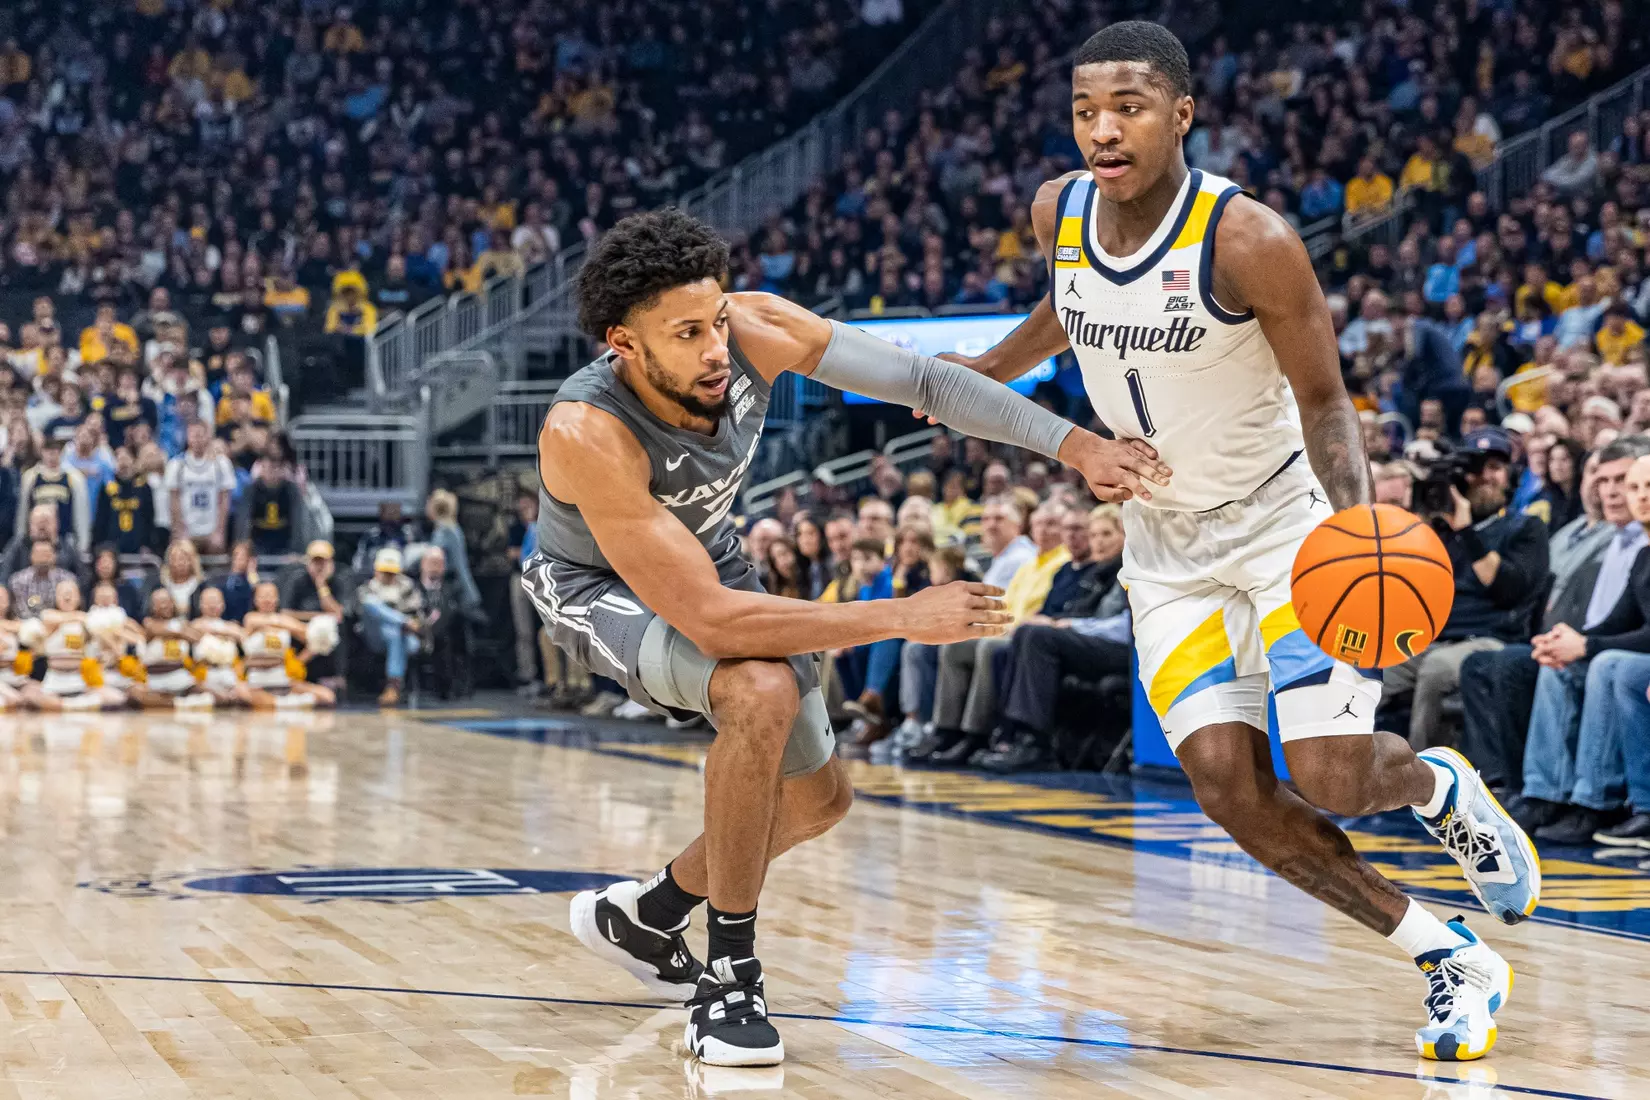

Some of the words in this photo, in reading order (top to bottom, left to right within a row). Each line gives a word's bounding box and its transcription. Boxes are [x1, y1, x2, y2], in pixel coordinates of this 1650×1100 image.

[1168, 295, 1188, 303] BIG
[1060, 306, 1207, 360] Marquette
[1124, 368, 1157, 438] 1
